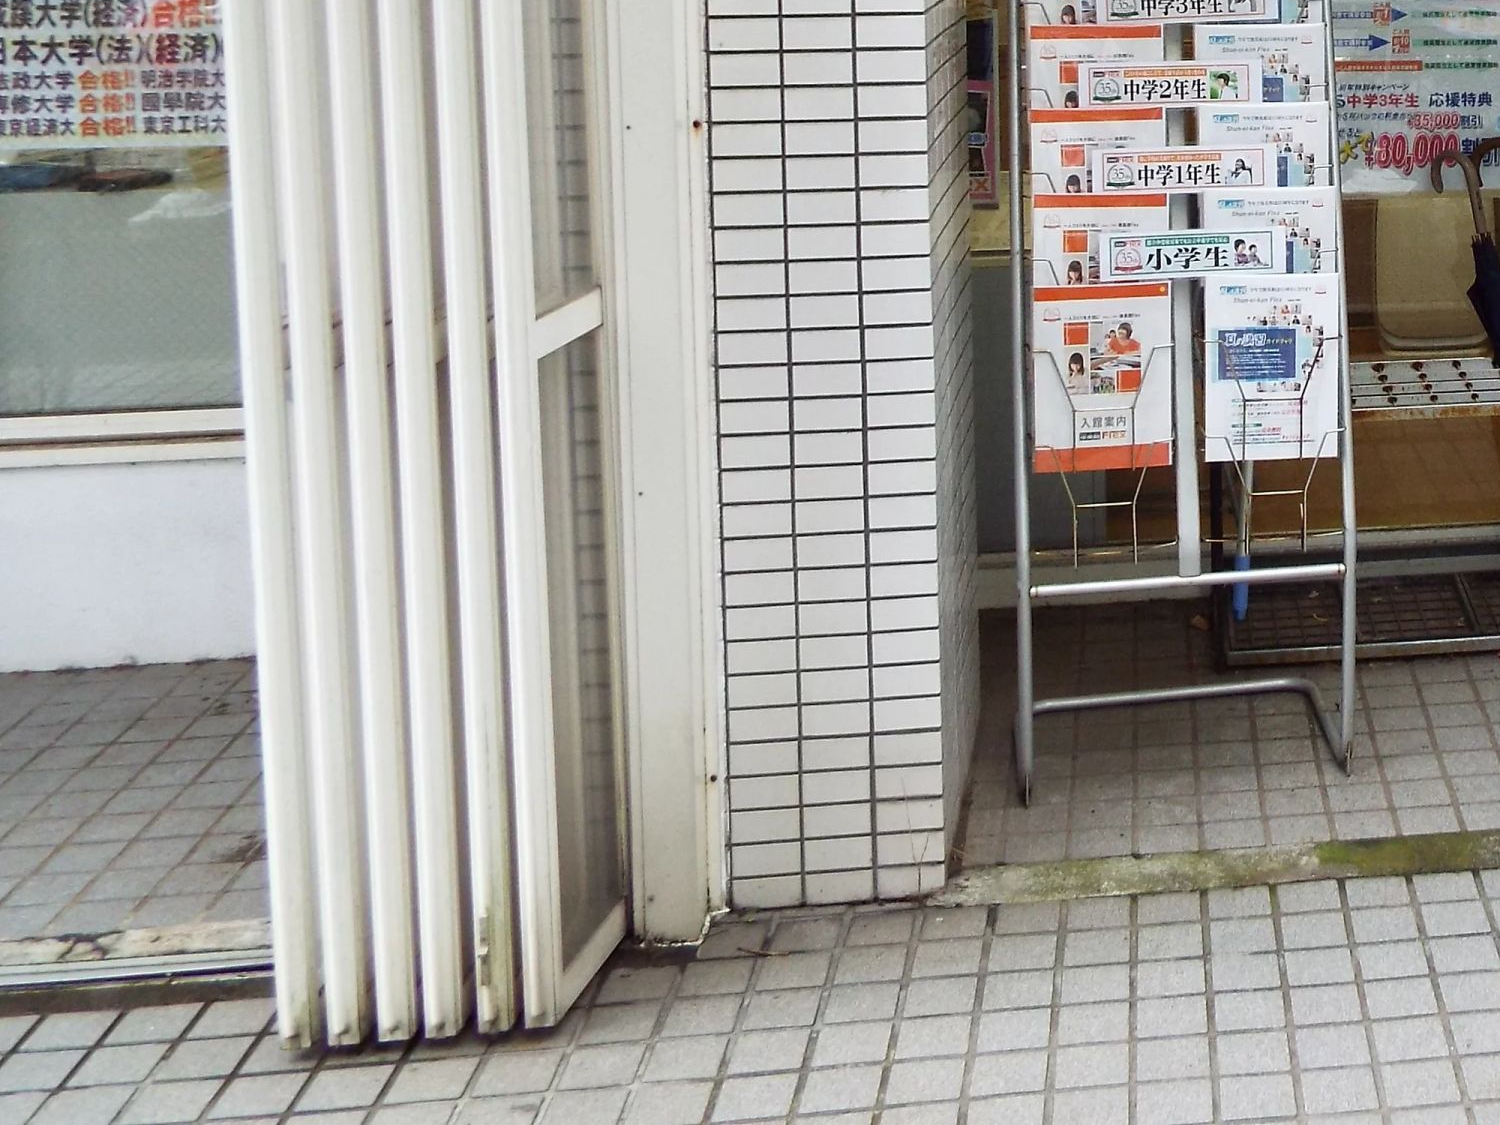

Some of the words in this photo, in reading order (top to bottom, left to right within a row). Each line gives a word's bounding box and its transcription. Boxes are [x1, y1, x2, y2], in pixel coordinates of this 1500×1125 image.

[1124, 78, 1207, 101] 中学2年生
[1429, 91, 1493, 108] 応援特典
[1137, 163, 1222, 187] 中学1年生
[1145, 246, 1230, 271] 小学生
[1081, 416, 1127, 429] 入館案内
